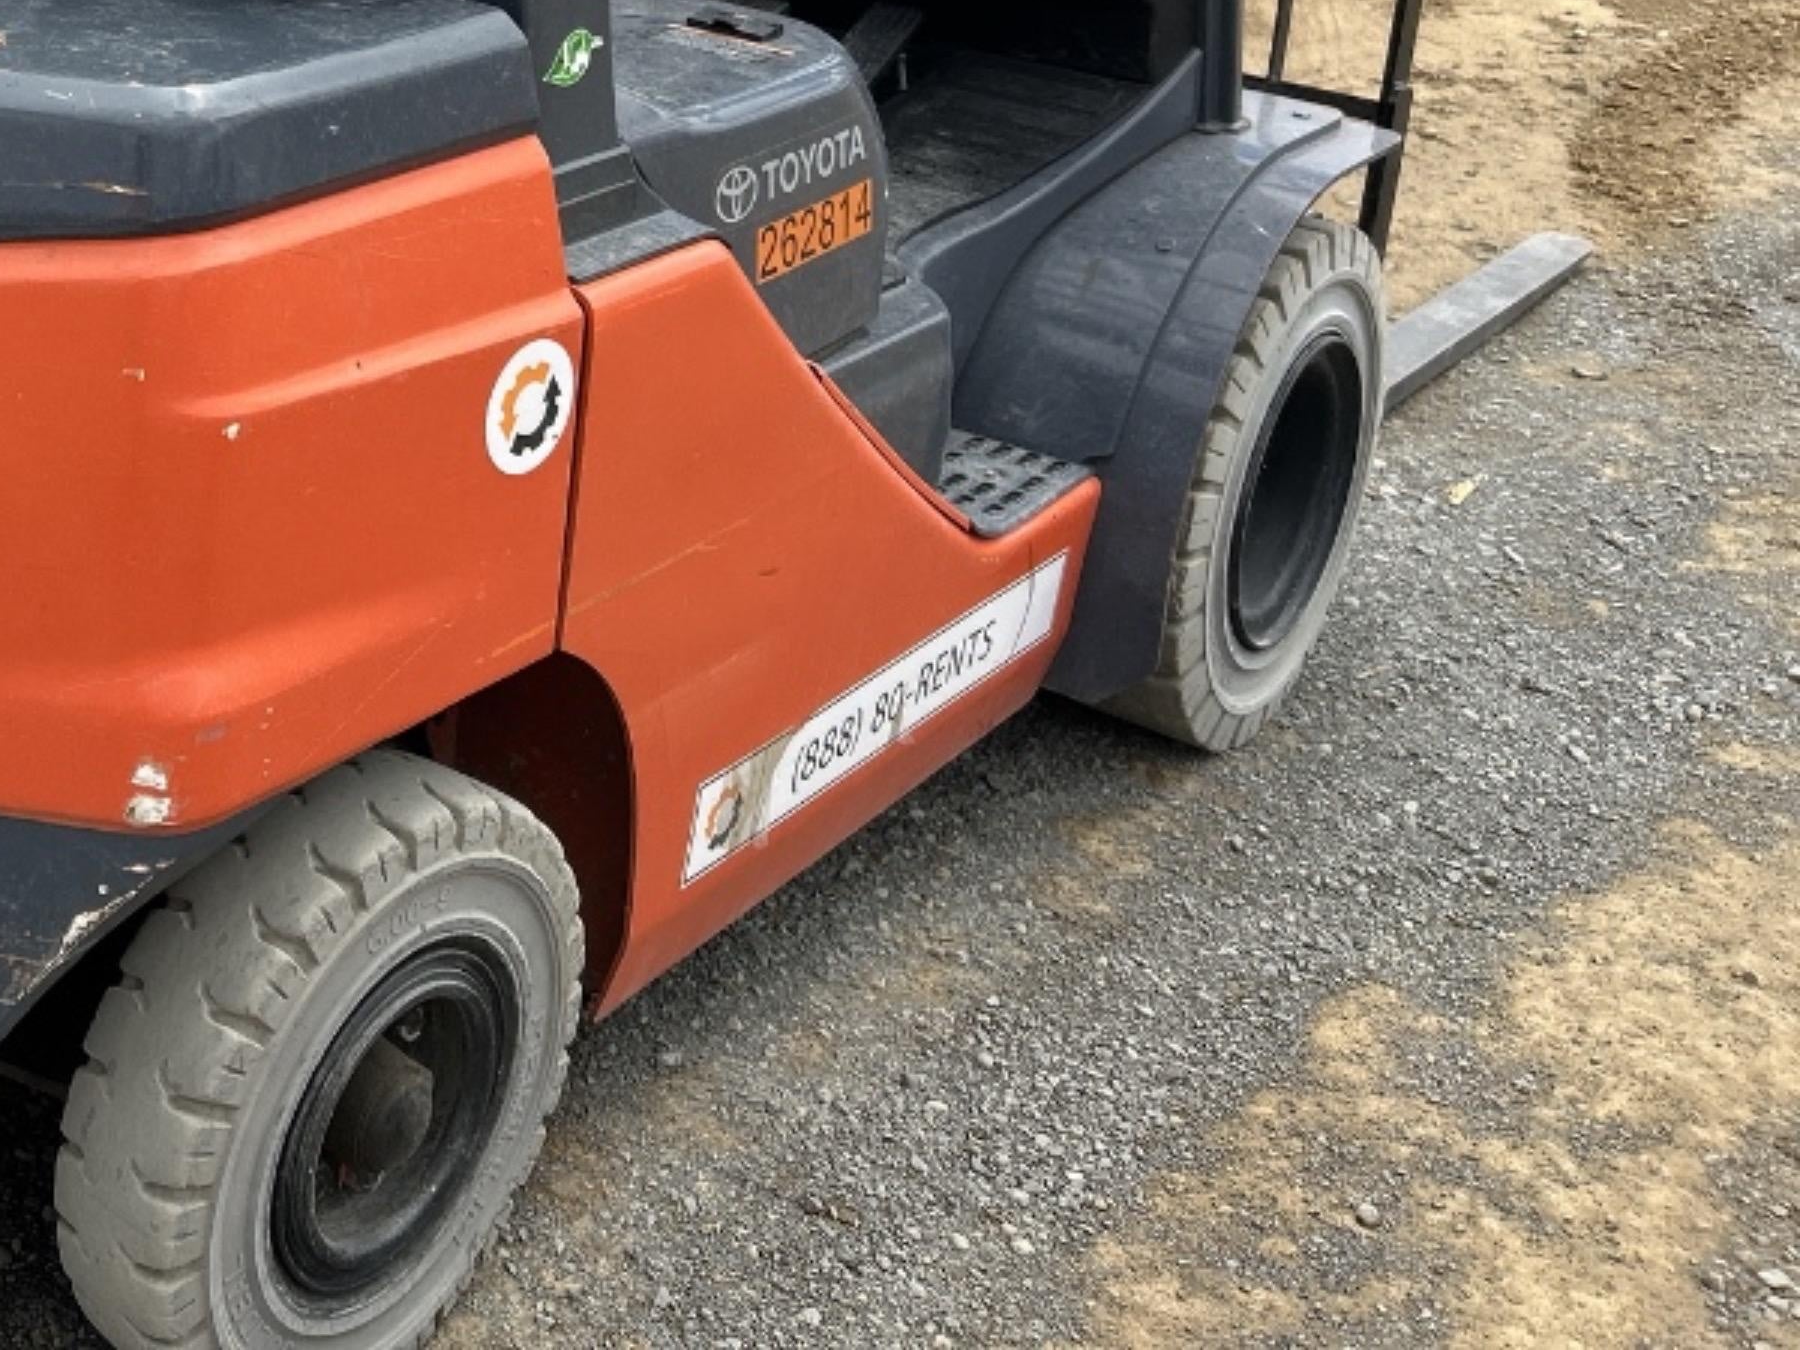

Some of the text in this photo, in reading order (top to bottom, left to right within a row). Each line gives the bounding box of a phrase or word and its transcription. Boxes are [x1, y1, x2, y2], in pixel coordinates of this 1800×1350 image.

[762, 125, 866, 201] TOYOTA
[761, 182, 870, 276] 262814
[790, 618, 997, 795] (888) 80-RENTS
